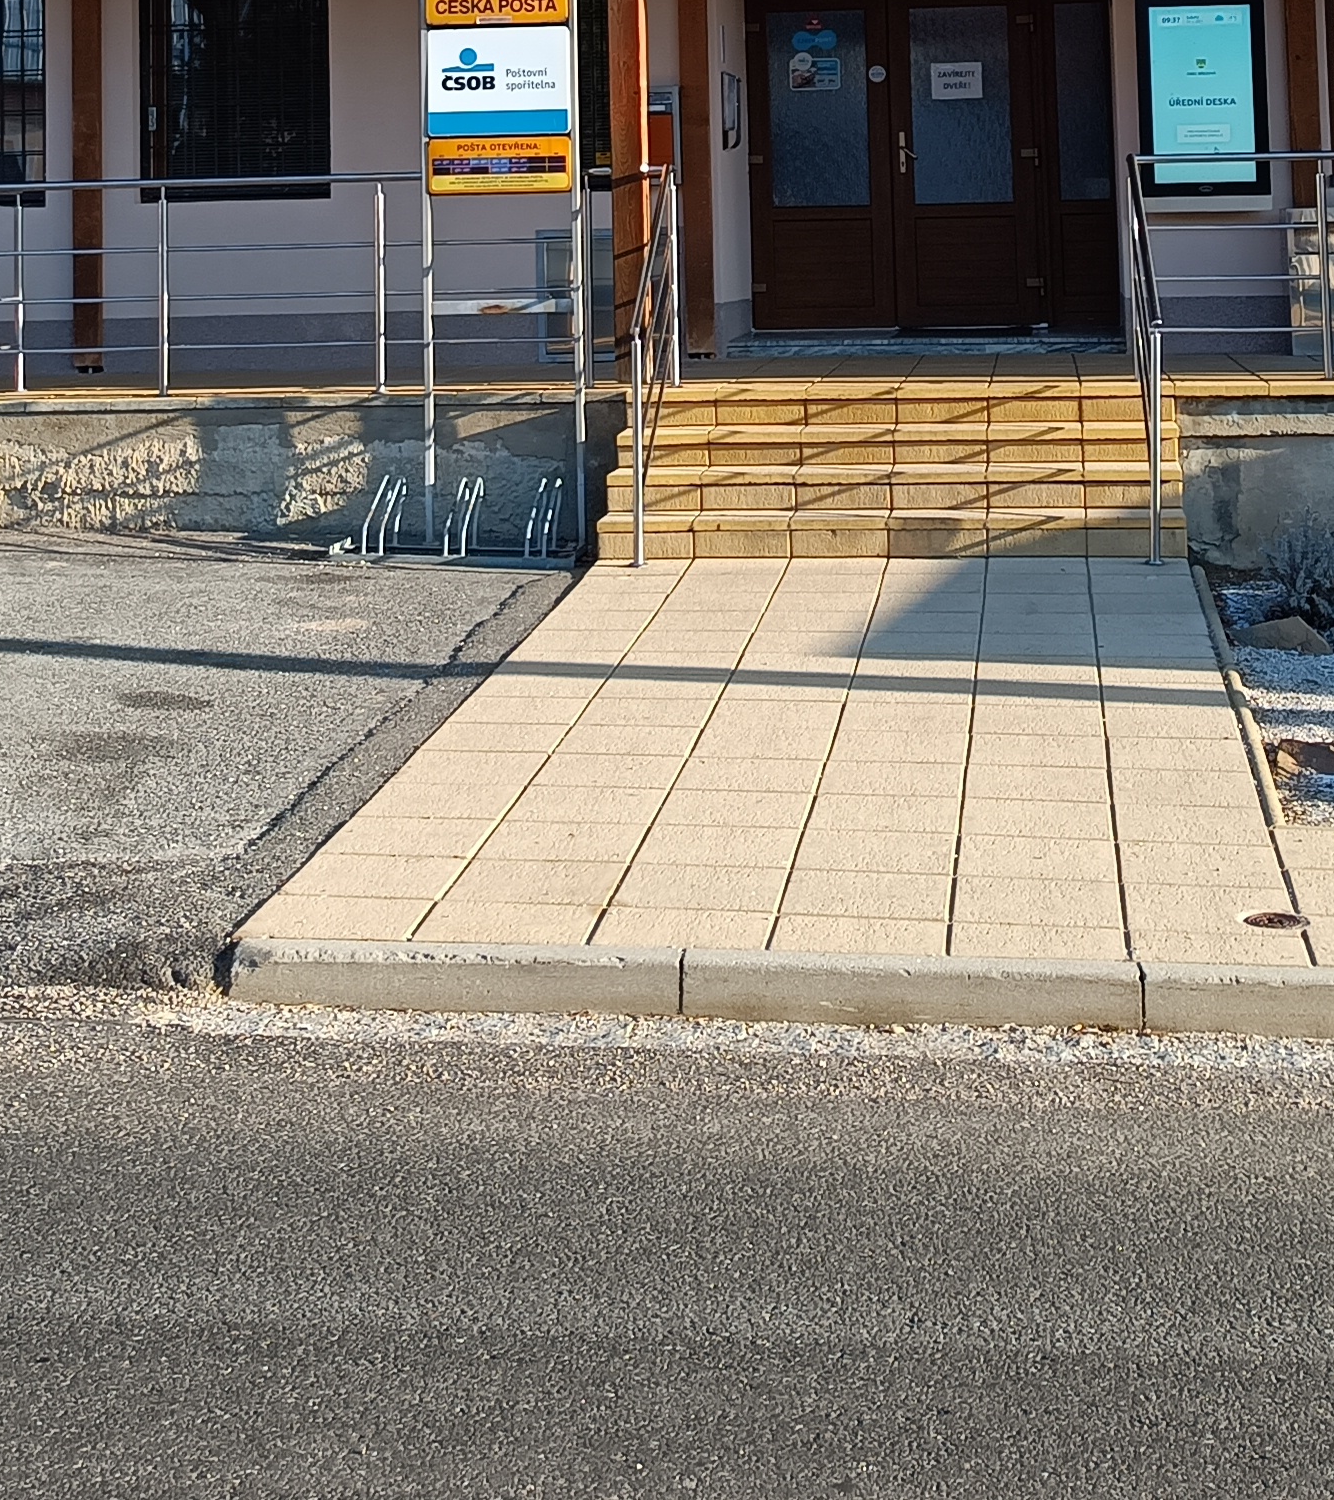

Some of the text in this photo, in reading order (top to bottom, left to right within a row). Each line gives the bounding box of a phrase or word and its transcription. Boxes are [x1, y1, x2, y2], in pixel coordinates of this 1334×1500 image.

[506, 66, 548, 78] Poštovní
[937, 69, 976, 78] ZAVÍREJTE
[441, 74, 496, 91] ČSOB
[505, 79, 556, 92] spořitelna
[1168, 97, 1237, 107] ÚŘEDNÍ DESKA
[456, 141, 542, 152] POŠTA OTEVŘENA:
